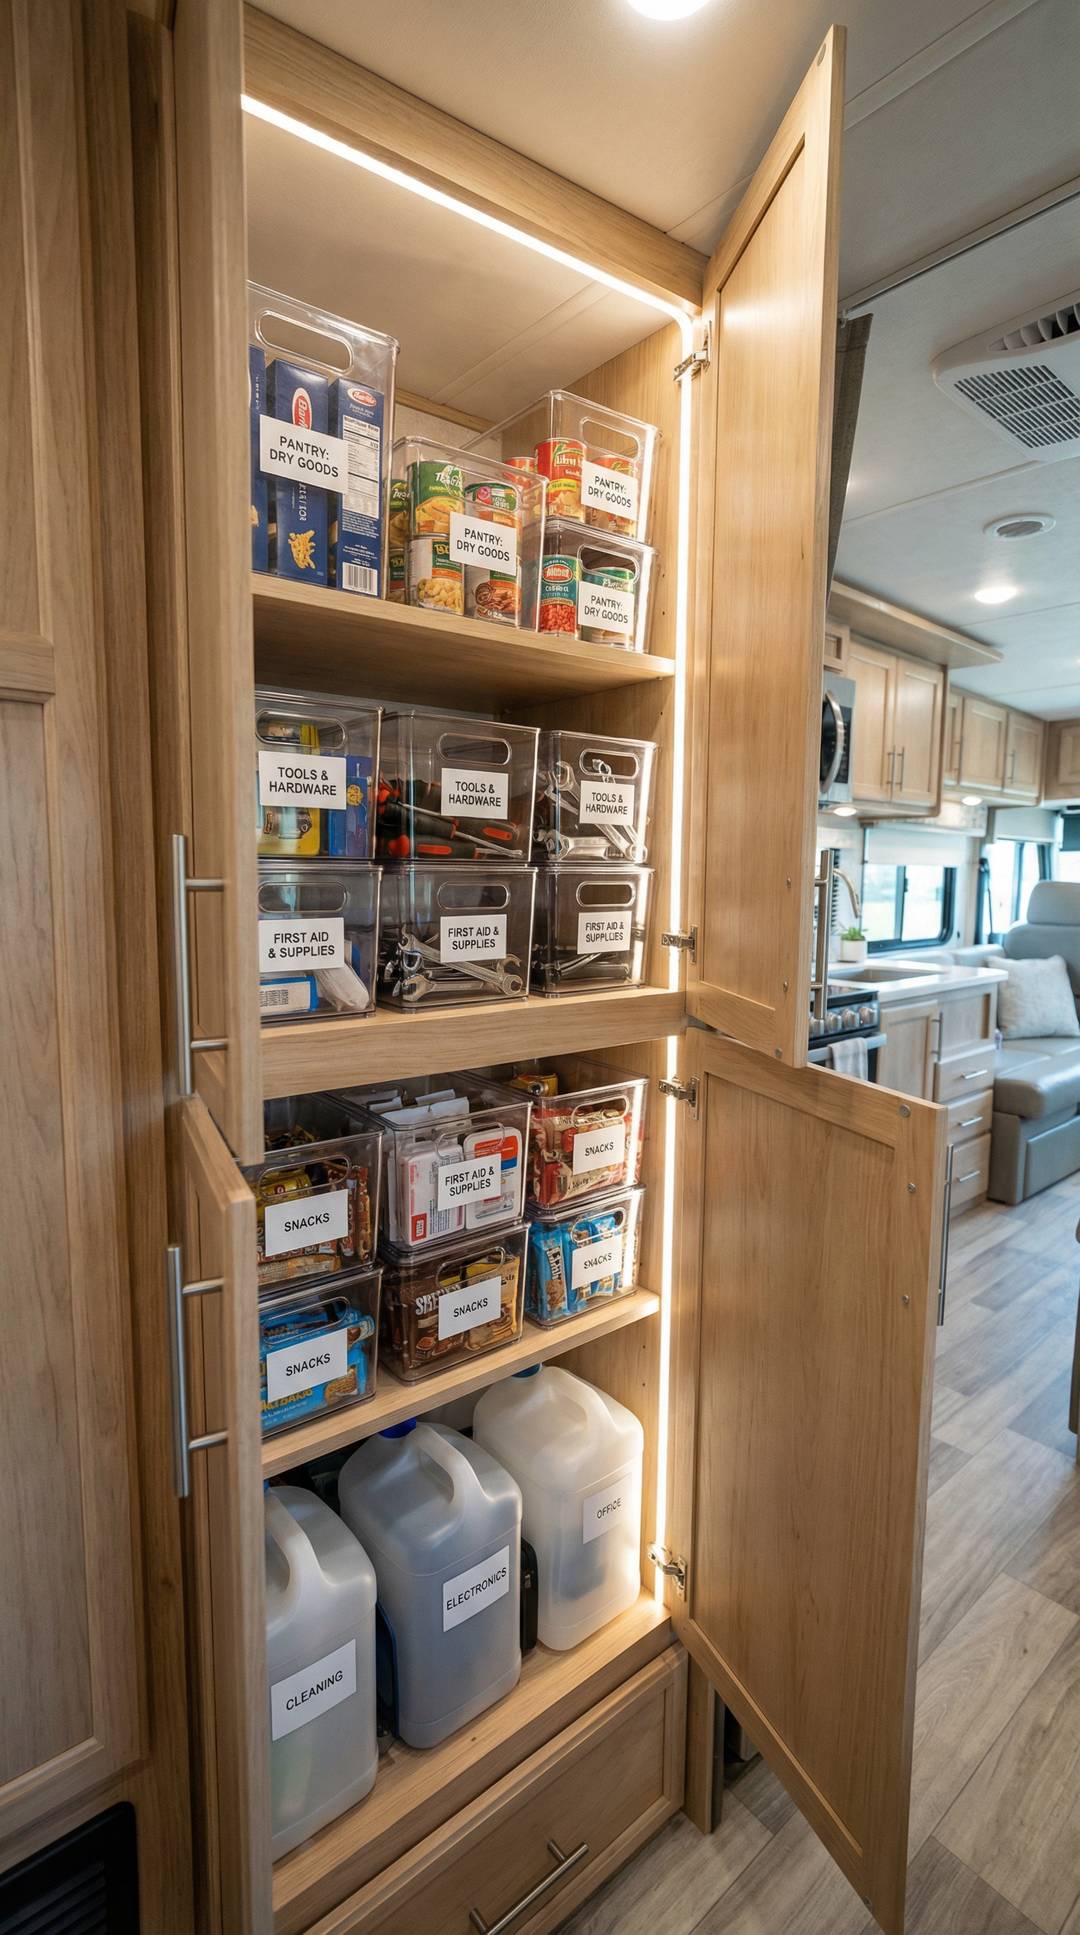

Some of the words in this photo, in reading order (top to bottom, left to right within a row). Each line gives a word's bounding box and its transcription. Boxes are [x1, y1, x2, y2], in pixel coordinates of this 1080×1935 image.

[280, 436, 329, 460] PANTRY:
[270, 448, 294, 465] DRY
[297, 457, 339, 478] GOODS
[594, 476, 627, 494] PANTRY:
[588, 486, 604, 498] DRY
[605, 491, 631, 508] GOODS
[464, 528, 503, 547] PANTRY:
[457, 539, 476, 553] DRY
[477, 545, 510, 562] GOODS
[584, 605, 600, 617] DRY
[601, 609, 628, 624] GOODS
[277, 766, 318, 780] TOOLS
[321, 770, 328, 781] &
[269, 781, 337, 796] HARDWARE
[455, 781, 486, 793] TOOLS
[488, 784, 495, 794] &
[449, 794, 501, 807] HARDWARE
[591, 792, 616, 803] TOOLS
[618, 794, 623, 803] &
[585, 803, 628, 815] HARDWARE
[448, 927, 474, 938] FIRST
[476, 926, 491, 937] AID
[493, 926, 499, 936] &
[585, 922, 605, 931] FIRST
[606, 921, 617, 931] AID
[618, 921, 625, 931] &
[274, 932, 307, 944] FIRST
[310, 931, 329, 943] AID
[452, 938, 496, 950] SUPPLIES
[268, 948, 276, 959] &
[279, 945, 335, 958] SUPPLIES
[584, 1142, 614, 1157] SNACKS
[445, 1171, 470, 1186] FIRST
[471, 1168, 486, 1182] AID
[488, 1166, 495, 1176] &
[449, 1178, 491, 1197] SUPPLIES
[284, 1212, 330, 1232] SNACKS
[583, 1252, 612, 1269] SNACKS
[453, 1297, 488, 1318] SNACKS
[286, 1353, 331, 1376] SNACKS
[596, 1498, 621, 1519] OFFICE
[446, 1567, 507, 1611] ELECTRONICS
[286, 1670, 343, 1711] CLEANING
